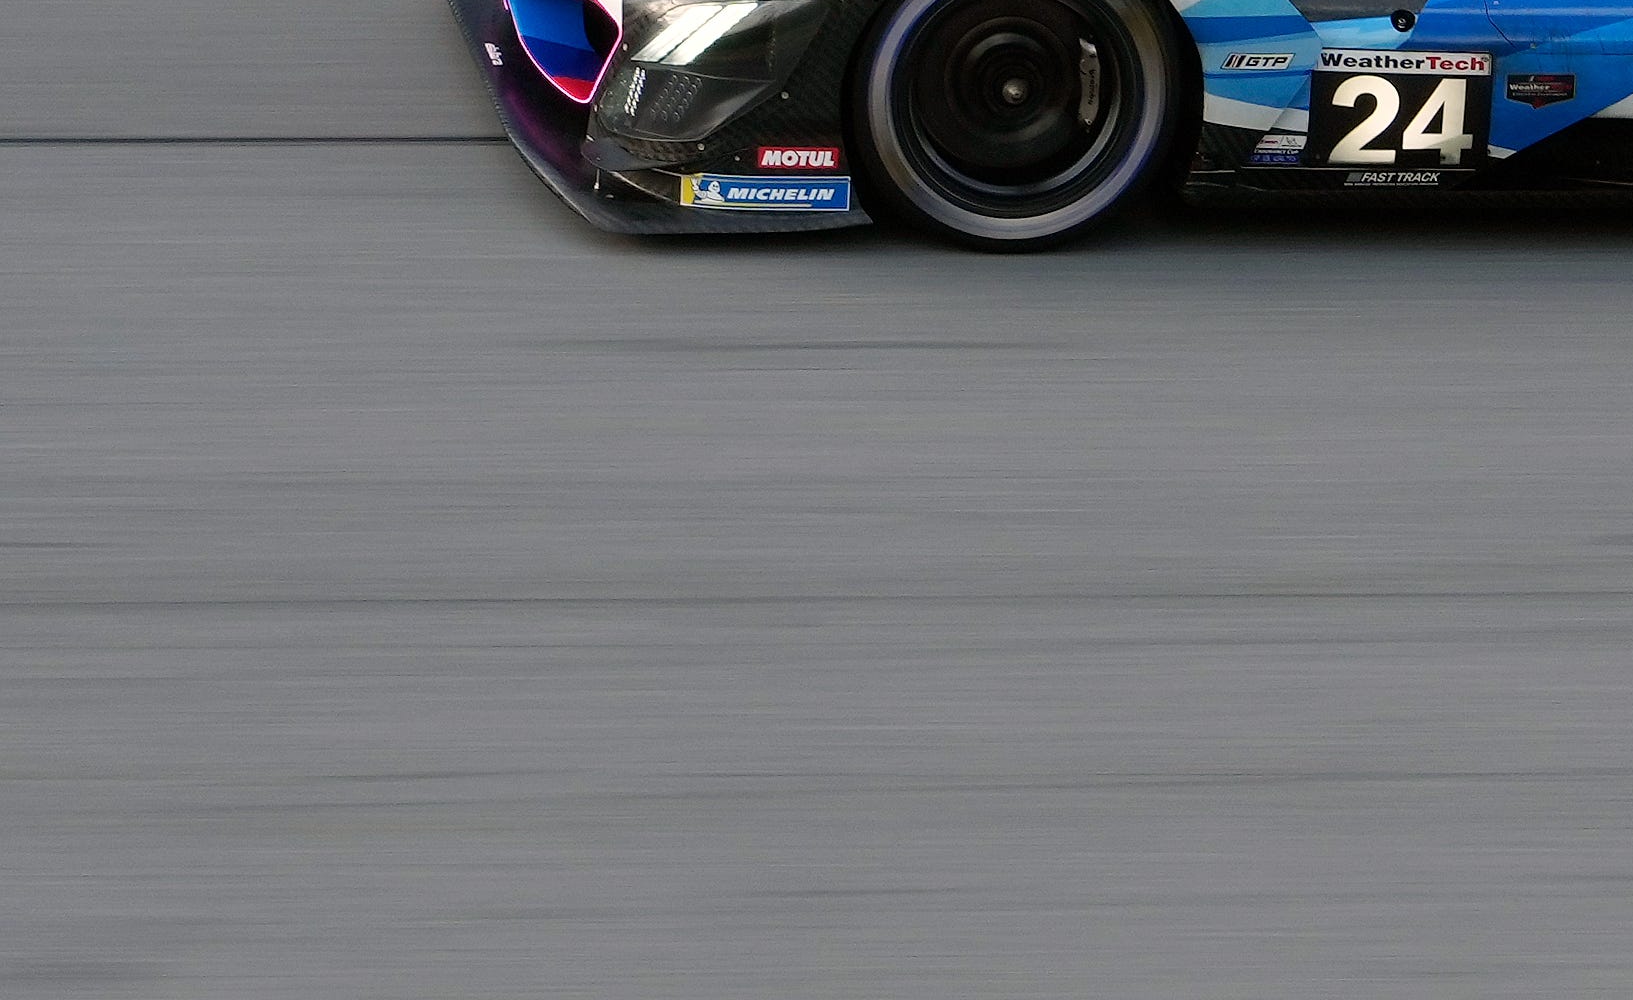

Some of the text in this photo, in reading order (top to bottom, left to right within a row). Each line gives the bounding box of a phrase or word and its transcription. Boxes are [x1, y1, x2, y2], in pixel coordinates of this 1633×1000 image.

[1246, 56, 1289, 67] GTP
[1321, 53, 1486, 71] WeatherTech
[1327, 75, 1473, 165] 24
[761, 150, 835, 167] MOTUL
[1361, 172, 1440, 183] FAST TRACK
[727, 187, 835, 201] MICHELIN
